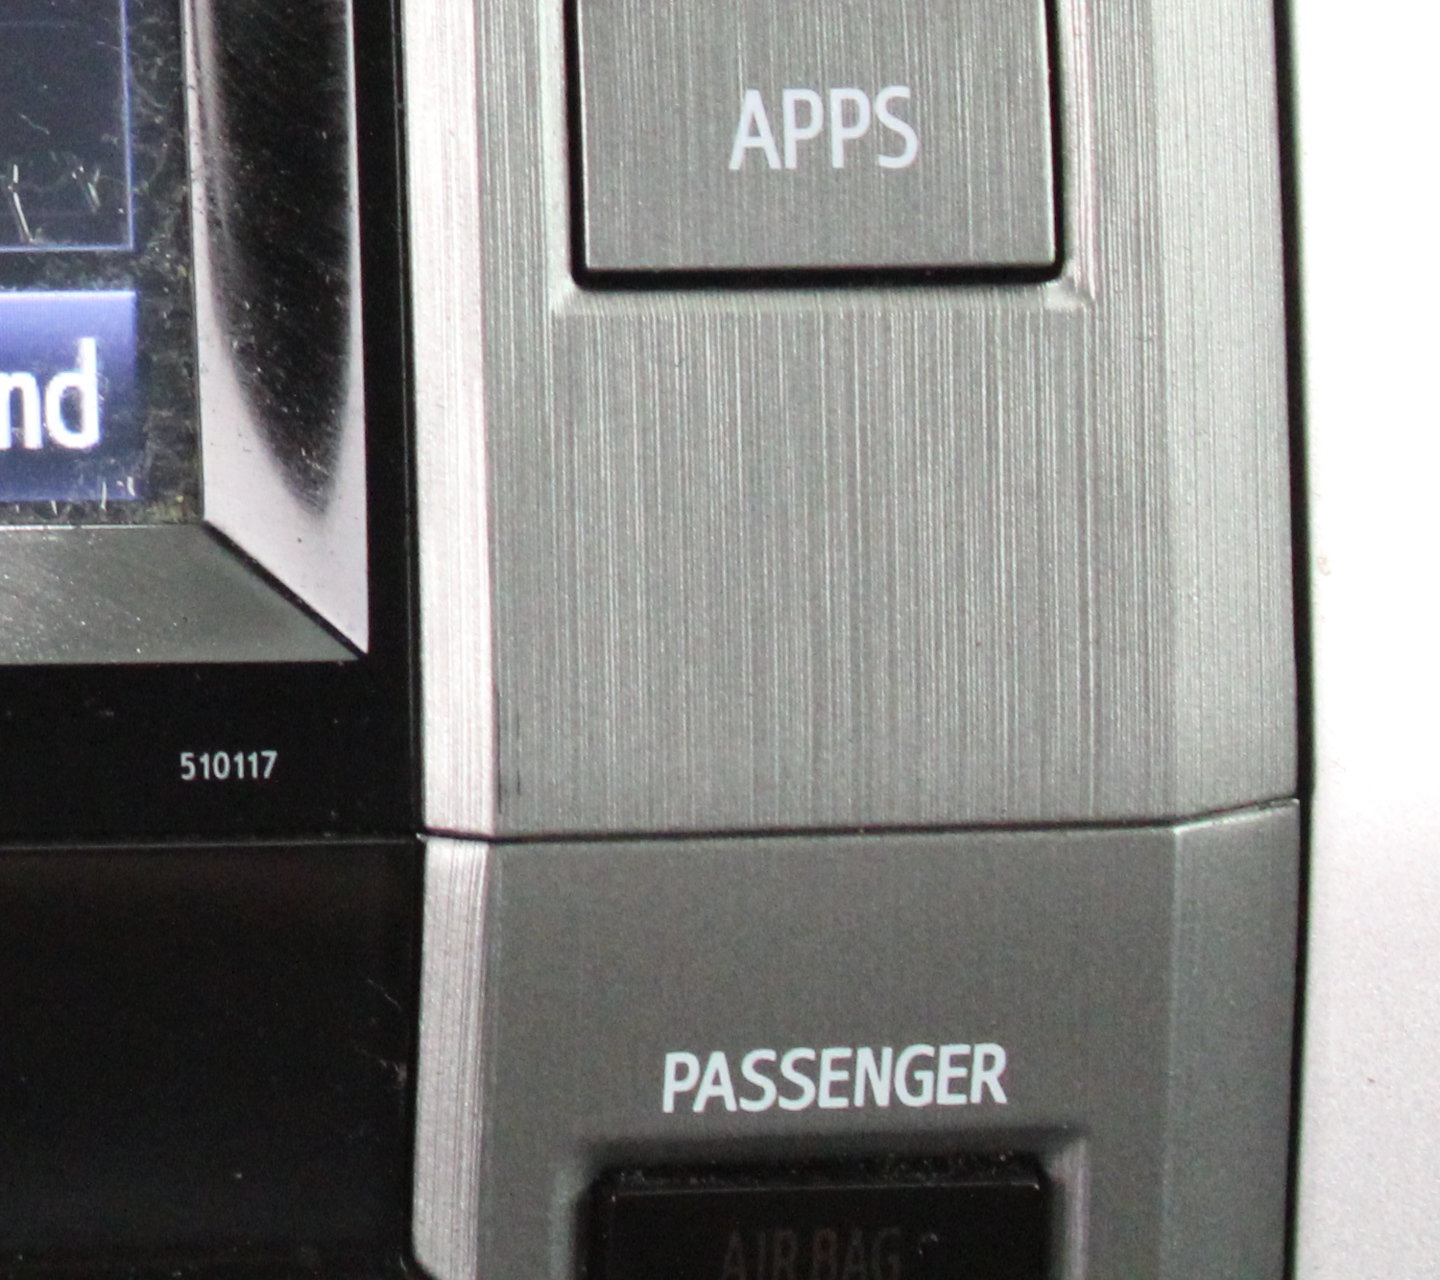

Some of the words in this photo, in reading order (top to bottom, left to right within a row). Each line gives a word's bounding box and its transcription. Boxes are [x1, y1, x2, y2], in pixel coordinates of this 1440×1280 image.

[728, 85, 920, 172] APPS
[179, 749, 279, 782] 510117
[660, 1041, 1009, 1115] PASSENGER
